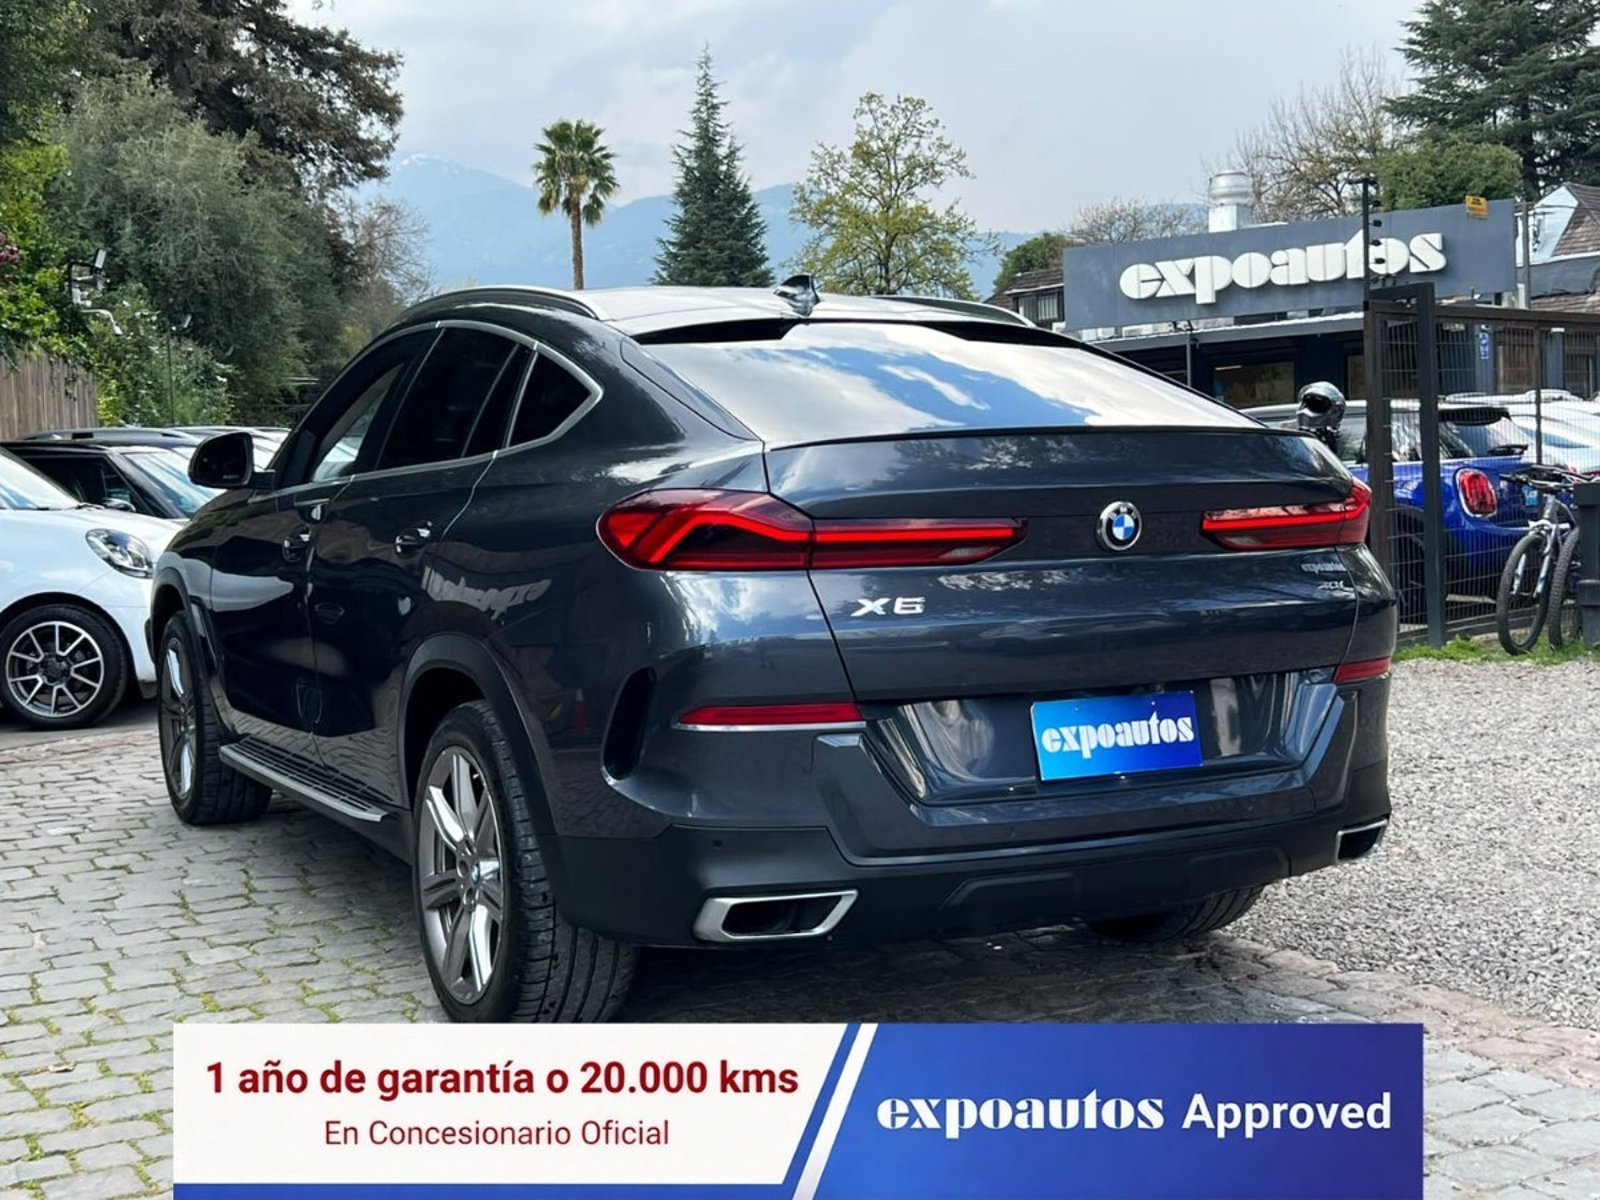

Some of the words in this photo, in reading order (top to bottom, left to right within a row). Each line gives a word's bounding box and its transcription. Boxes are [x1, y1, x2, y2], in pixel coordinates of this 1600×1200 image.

[1119, 229, 1447, 305] expoautos
[850, 597, 926, 617] X6
[1041, 711, 1194, 759] expoautos
